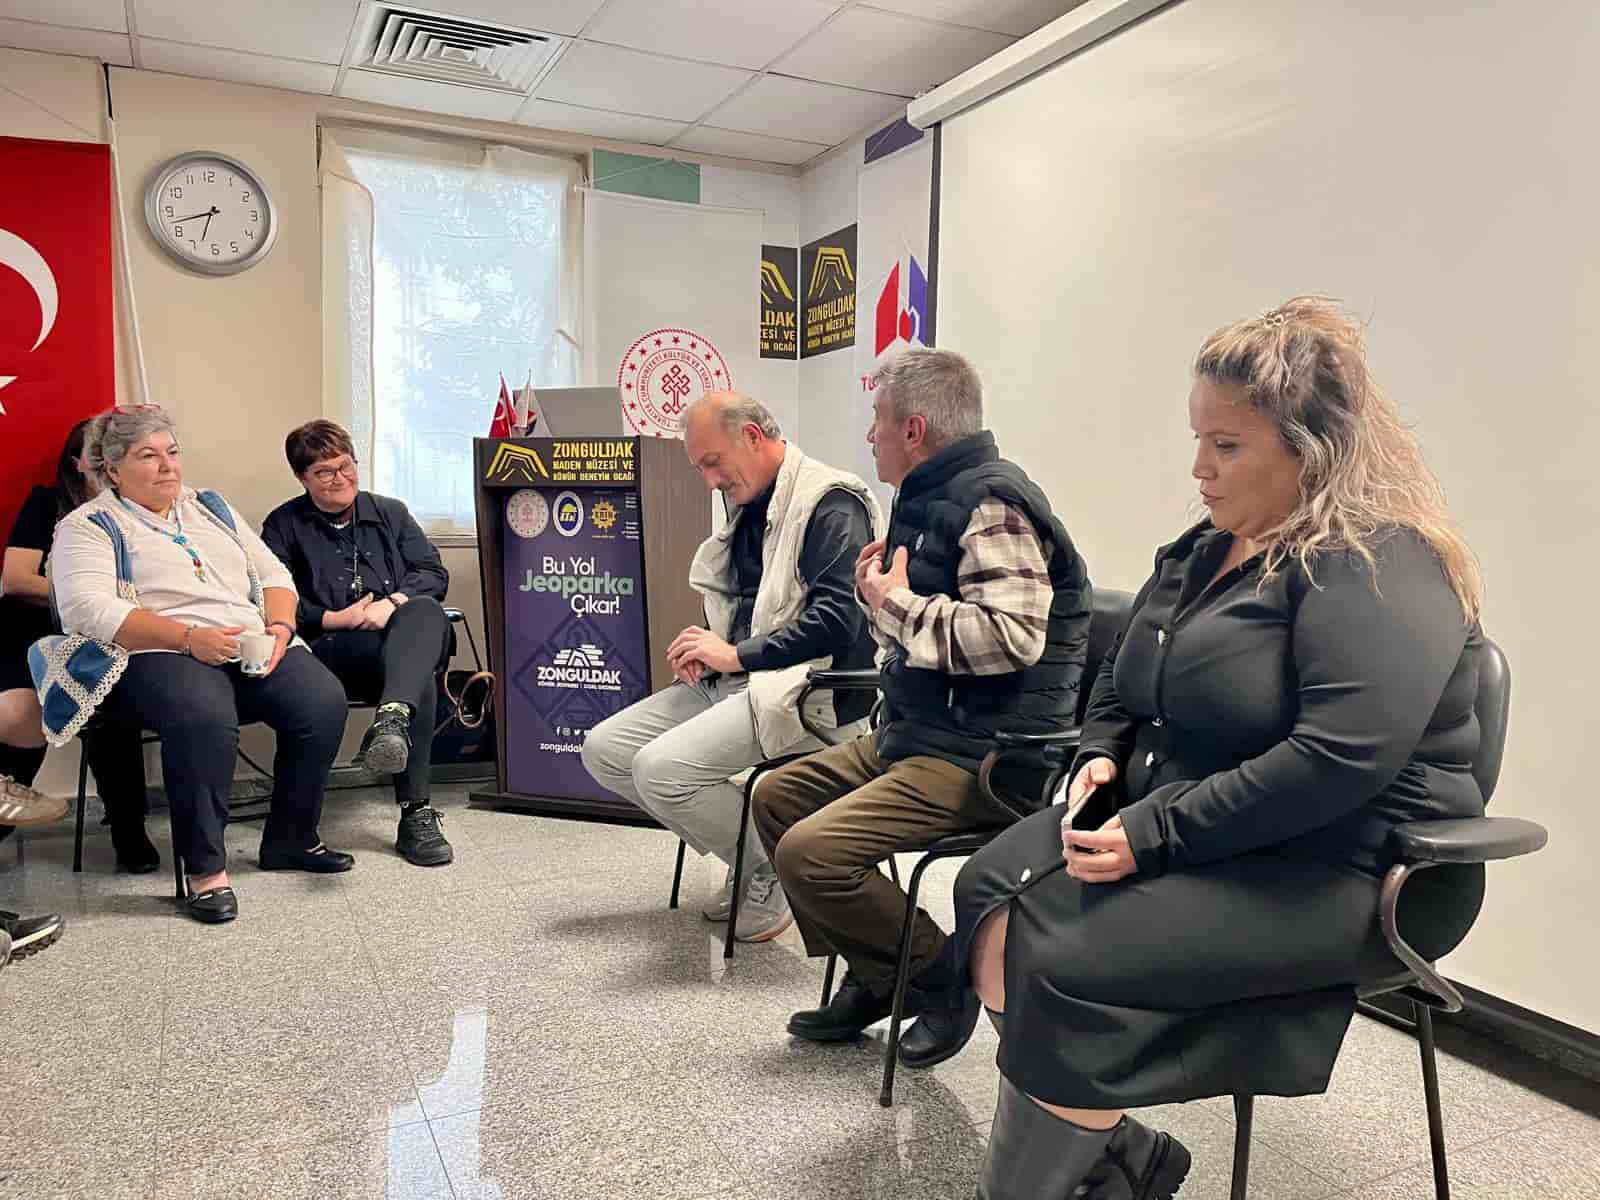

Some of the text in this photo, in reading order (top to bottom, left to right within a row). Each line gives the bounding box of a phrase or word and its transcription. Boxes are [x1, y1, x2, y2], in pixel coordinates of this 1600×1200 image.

[186, 175, 194, 185] 11
[203, 171, 216, 183] 12
[169, 187, 183, 199] 10
[242, 191, 250, 203] 2
[165, 206, 174, 217] 9
[249, 210, 258, 222] 3
[174, 225, 183, 238] 8
[244, 228, 254, 240] 4
[188, 239, 196, 249] 7
[210, 243, 220, 256] 6
[229, 241, 238, 253] 5
[807, 294, 855, 325] ZONGULDAK
[783, 330, 796, 341] VE
[552, 442, 634, 458] ZONGULDAK
[586, 458, 618, 470] MÜZESİ
[623, 460, 635, 470] VE
[543, 556, 595, 576] Bu Yol
[519, 569, 633, 599] Jeoparka
[571, 594, 620, 618] Çıkar!
[537, 666, 621, 684] ZONGULDAK
